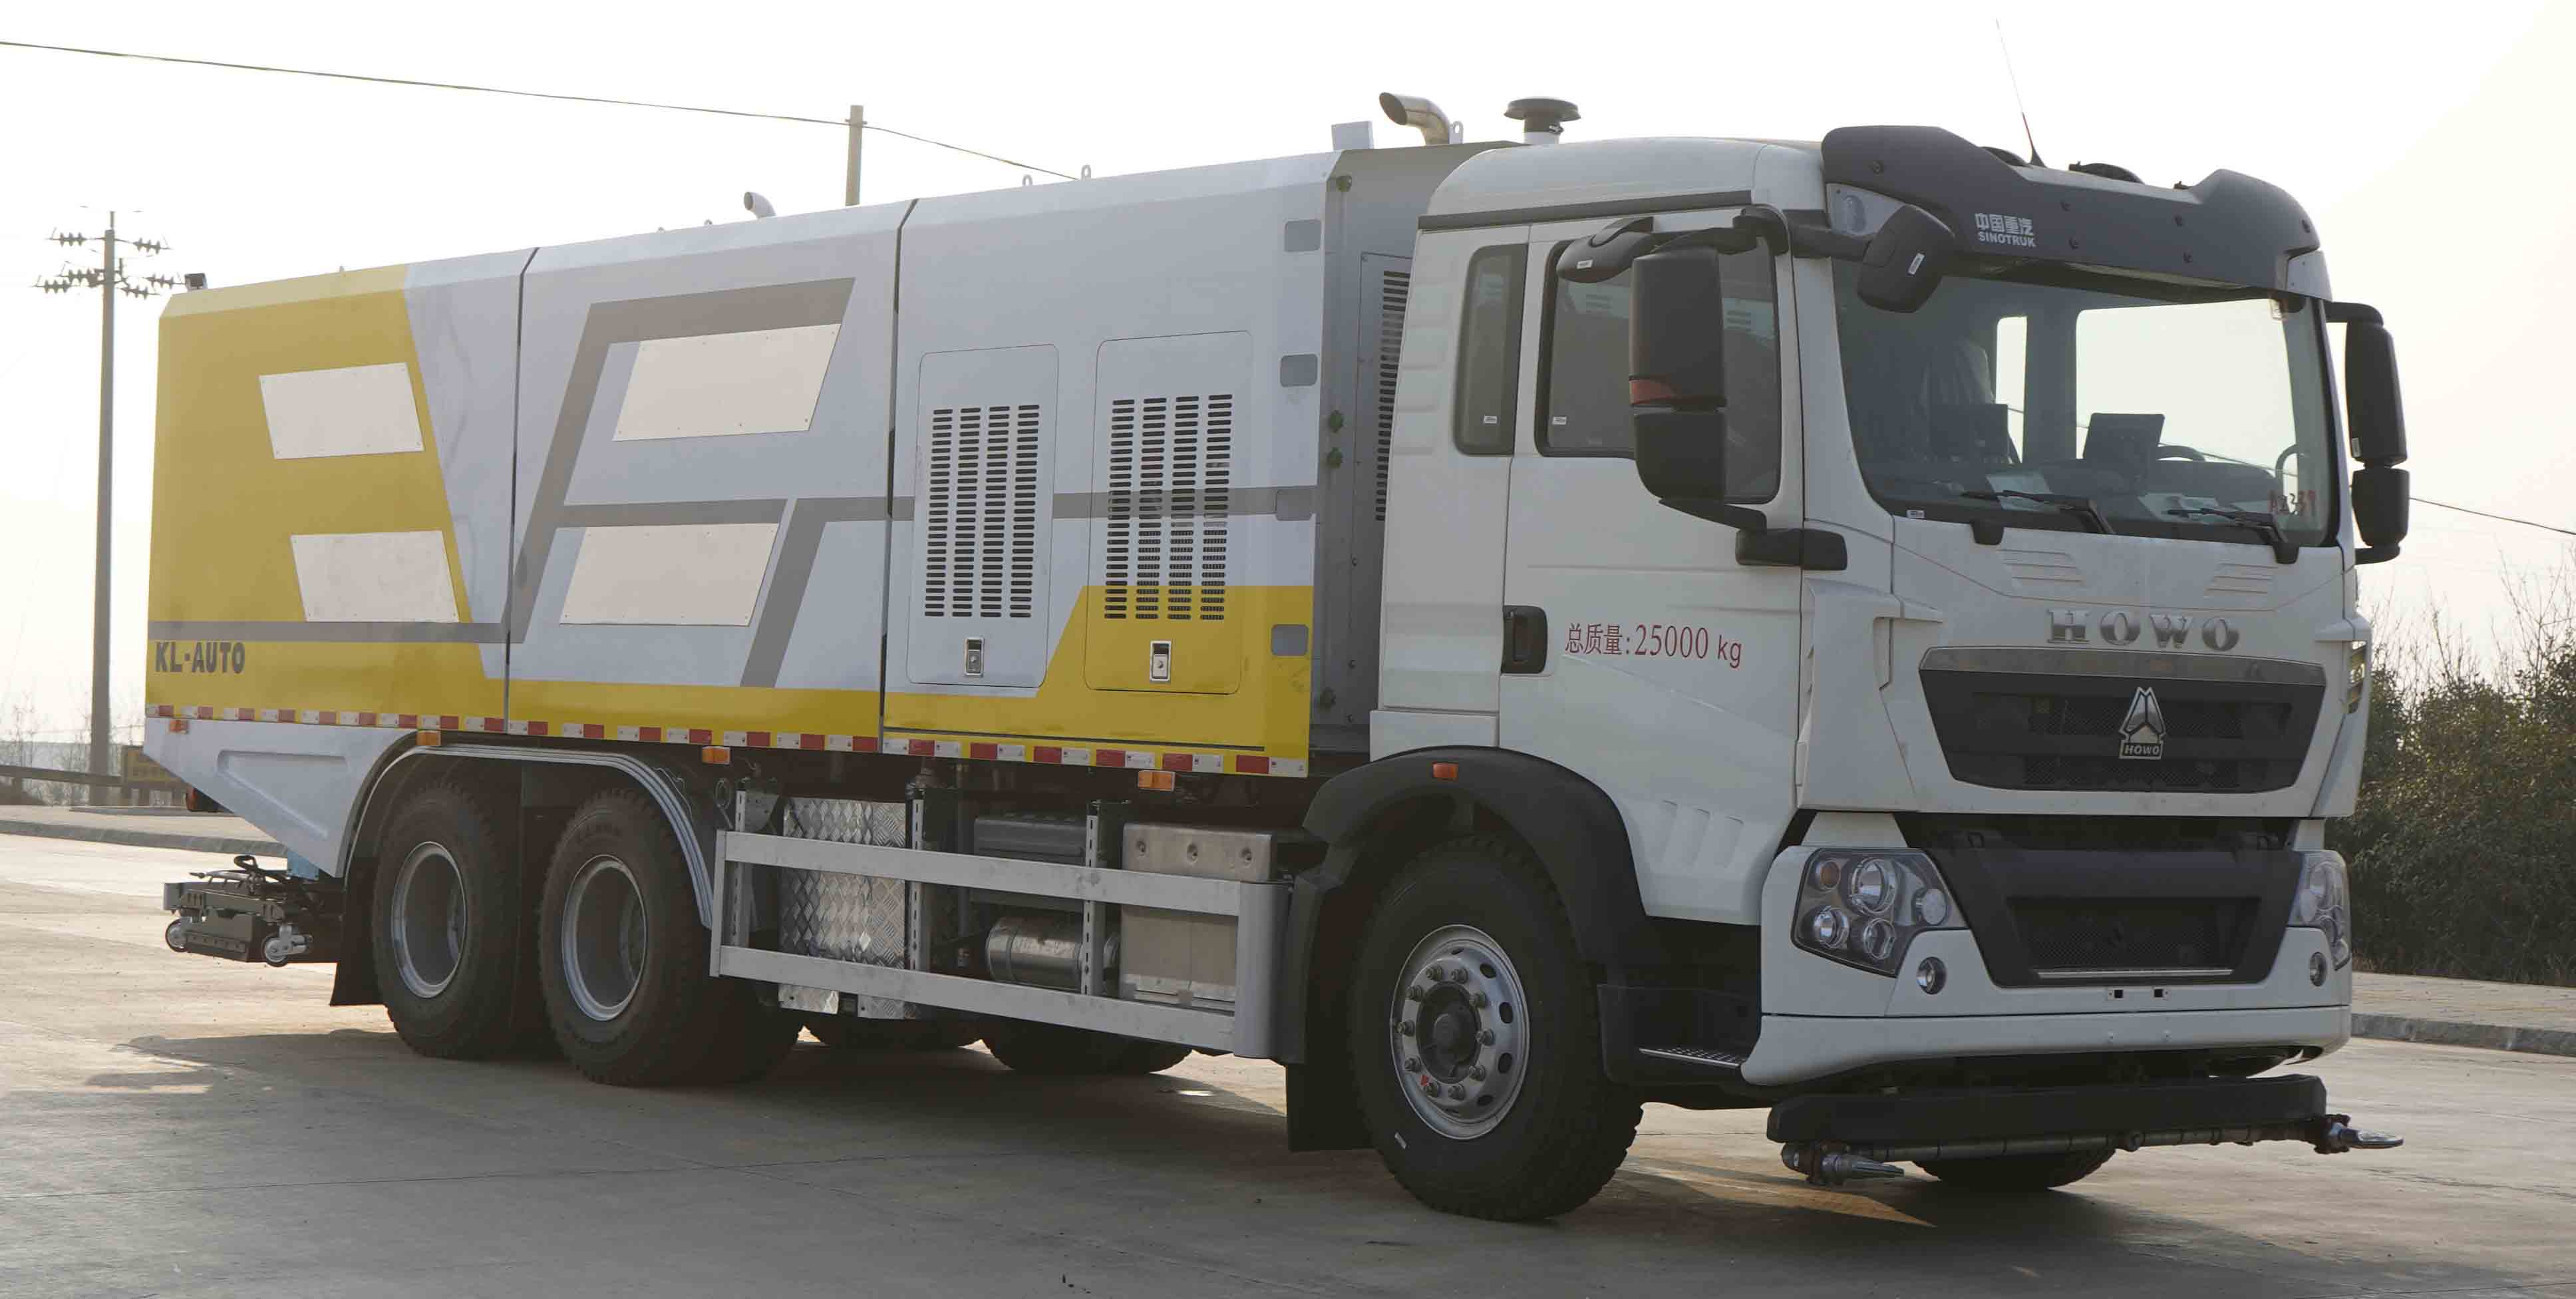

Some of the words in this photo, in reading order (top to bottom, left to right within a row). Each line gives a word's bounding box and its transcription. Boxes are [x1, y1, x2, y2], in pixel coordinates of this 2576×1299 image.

[1975, 212, 2034, 236] 中国重汽
[1978, 232, 2036, 248] SINOTRUK
[2046, 608, 2240, 651] HOWO
[155, 642, 245, 673] KL-AUTO
[1717, 634, 1742, 668] kg
[2124, 745, 2160, 755] HOWO
